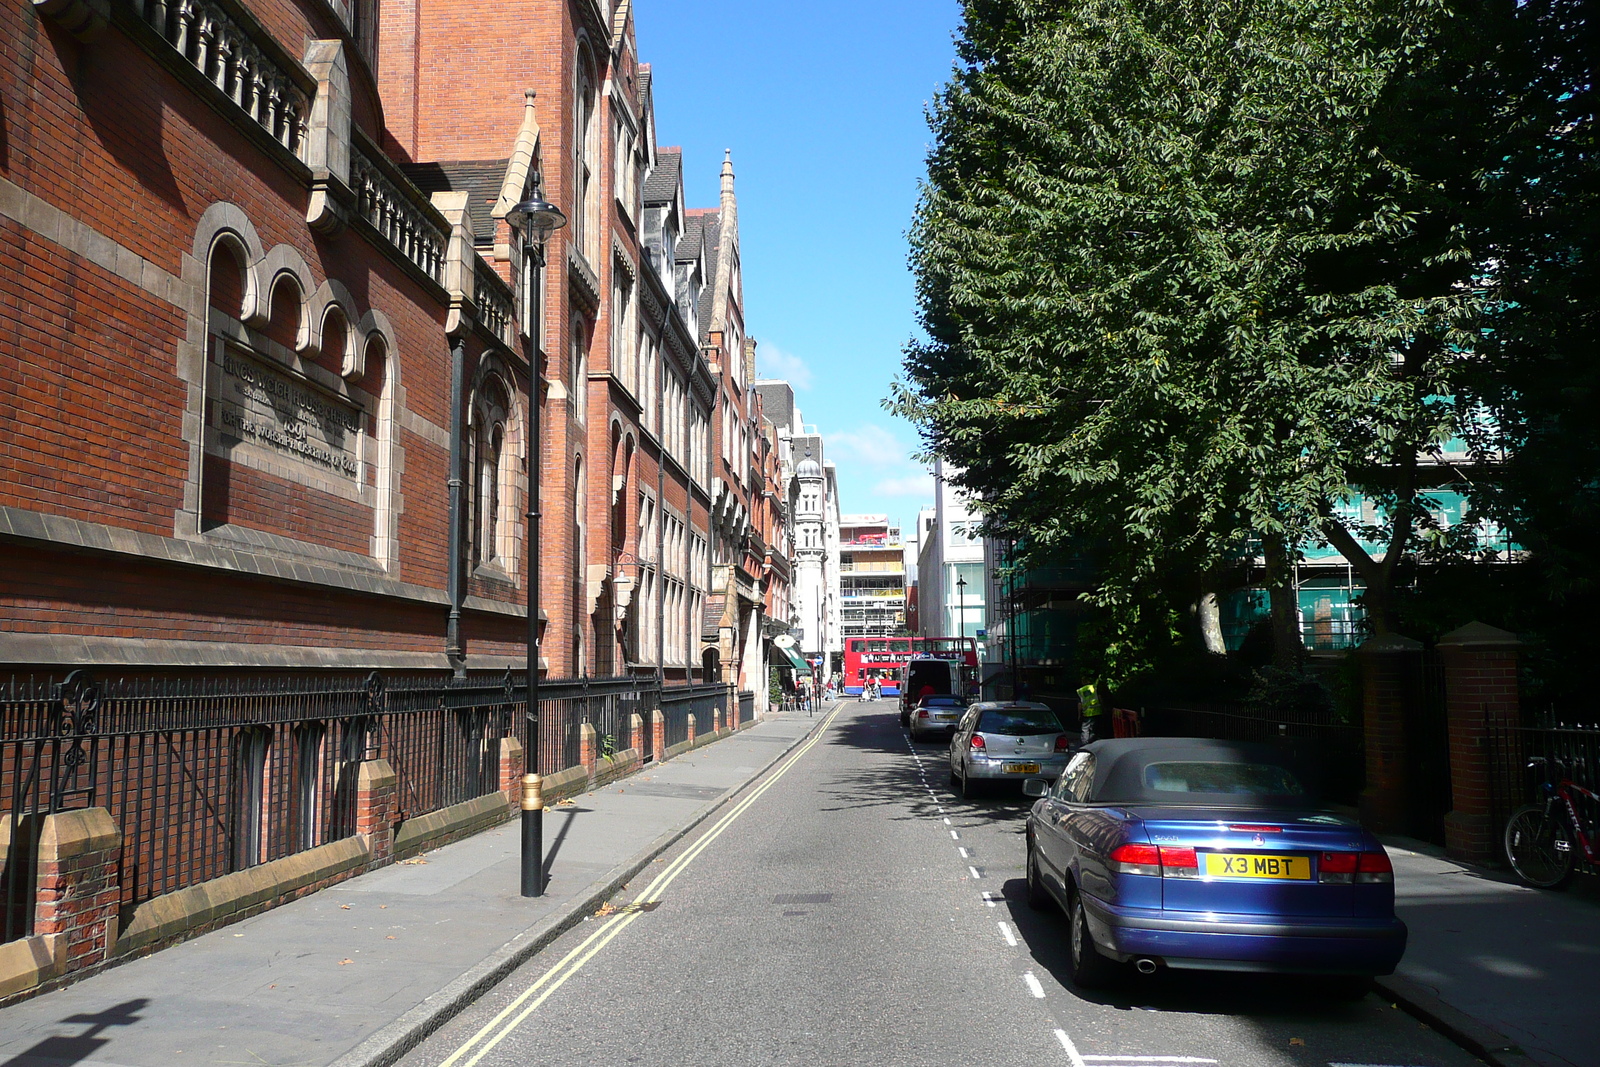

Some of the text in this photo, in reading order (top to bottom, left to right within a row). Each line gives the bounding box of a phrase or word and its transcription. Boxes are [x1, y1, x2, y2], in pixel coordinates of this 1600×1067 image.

[293, 391, 323, 415] HOUSE
[239, 417, 254, 433] THE
[283, 415, 306, 439] 1891
[1223, 857, 1293, 875] X3 MBT
